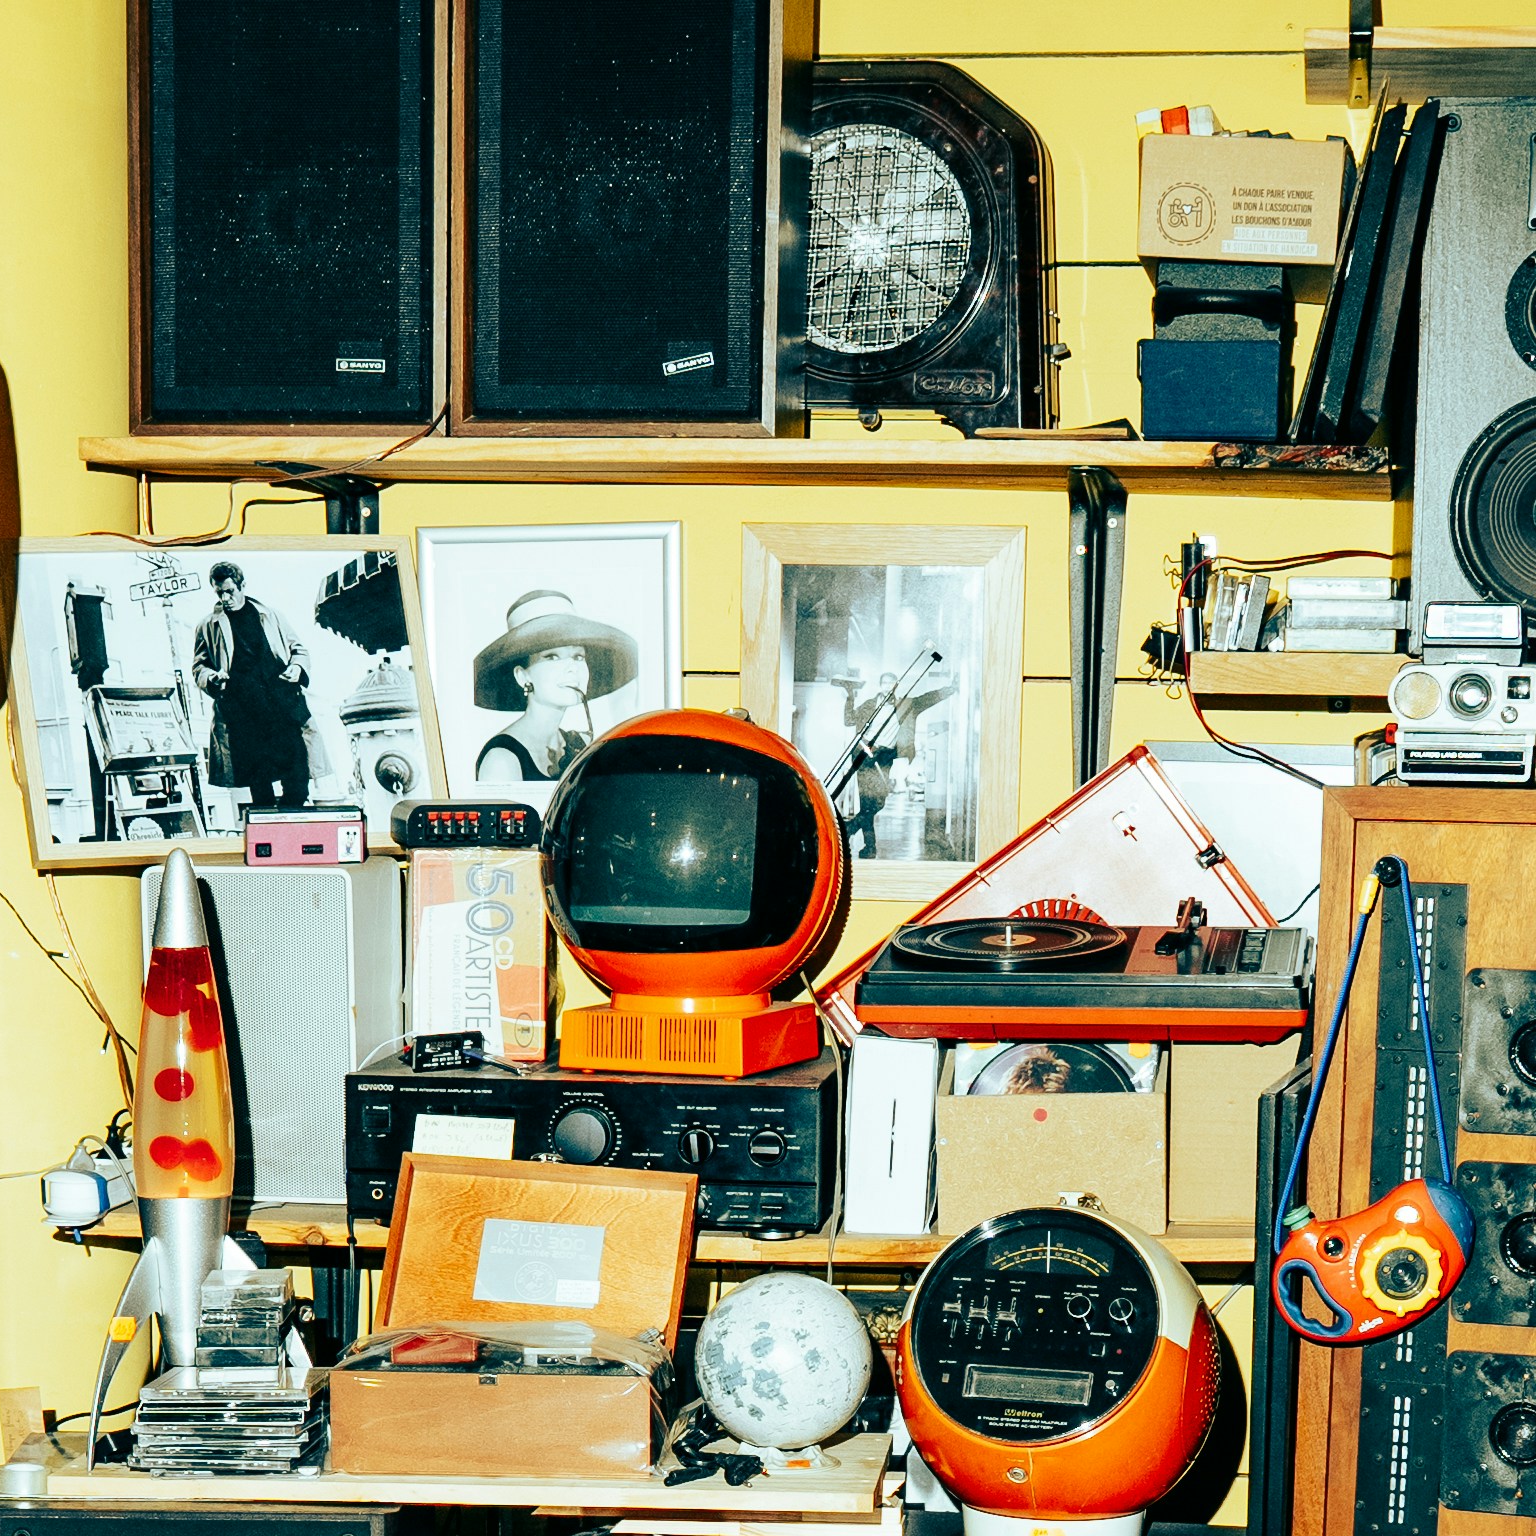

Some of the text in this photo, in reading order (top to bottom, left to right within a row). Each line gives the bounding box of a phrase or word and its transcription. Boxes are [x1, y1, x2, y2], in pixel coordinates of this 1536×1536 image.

[1238, 188, 1263, 198] CHAQUE
[1265, 190, 1285, 199] PAIRE
[1232, 202, 1242, 211] UN
[1243, 202, 1256, 212] DON
[1264, 203, 1313, 213] L'ASSOCIATION
[1231, 215, 1312, 227] LES BOUCHONS D'AMOUR
[1234, 228, 1306, 240] AIDE AUX PERSONNES
[1223, 242, 1316, 255] EN SITUATION DE HANDICAP
[676, 356, 711, 370] SANYO
[140, 579, 188, 595] TAYLOR
[465, 861, 514, 936] 50
[495, 936, 514, 970] CD
[510, 1223, 578, 1236] DIGITAL
[497, 1232, 586, 1251] IXUS 300
[1004, 1408, 1044, 1418] Weltron
